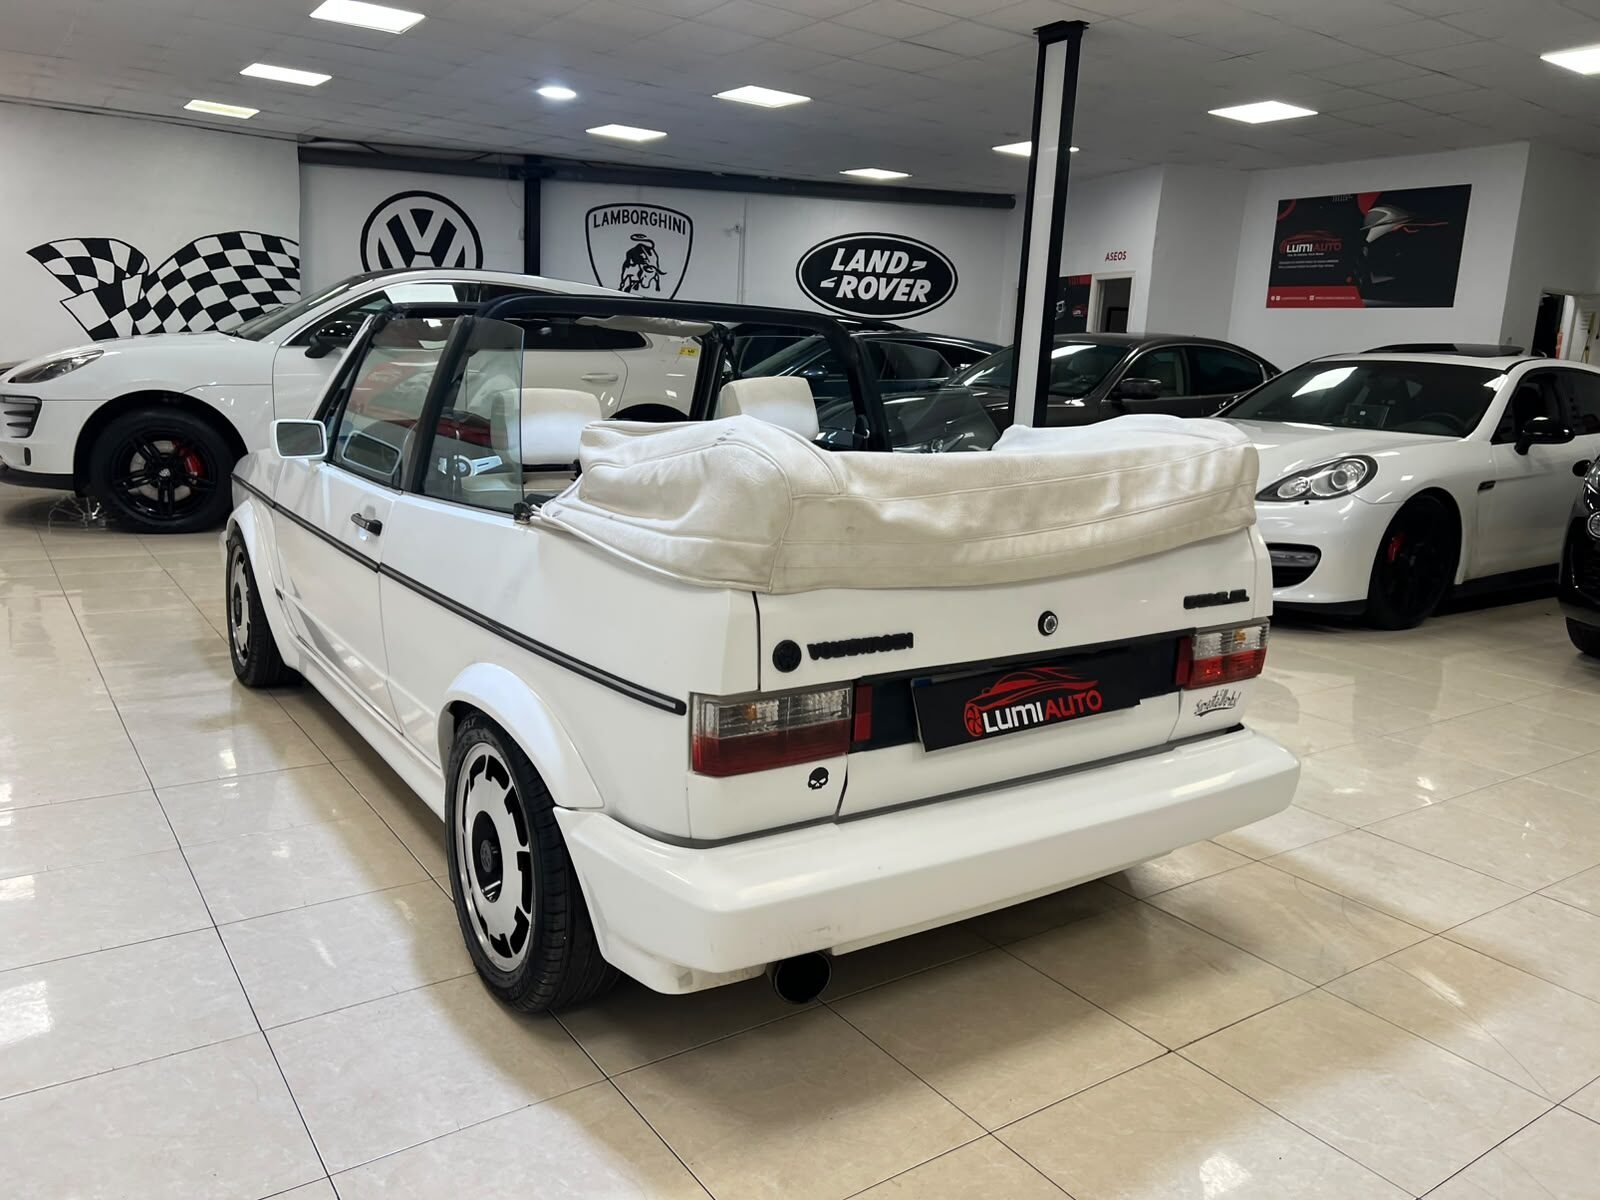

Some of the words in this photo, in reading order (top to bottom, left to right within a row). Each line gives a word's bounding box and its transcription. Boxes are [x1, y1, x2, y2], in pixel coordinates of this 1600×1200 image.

[592, 210, 689, 236] LAMBORGHINI
[830, 248, 910, 274] LAND
[1105, 251, 1127, 262] ASEOS
[836, 274, 932, 303] ROVER
